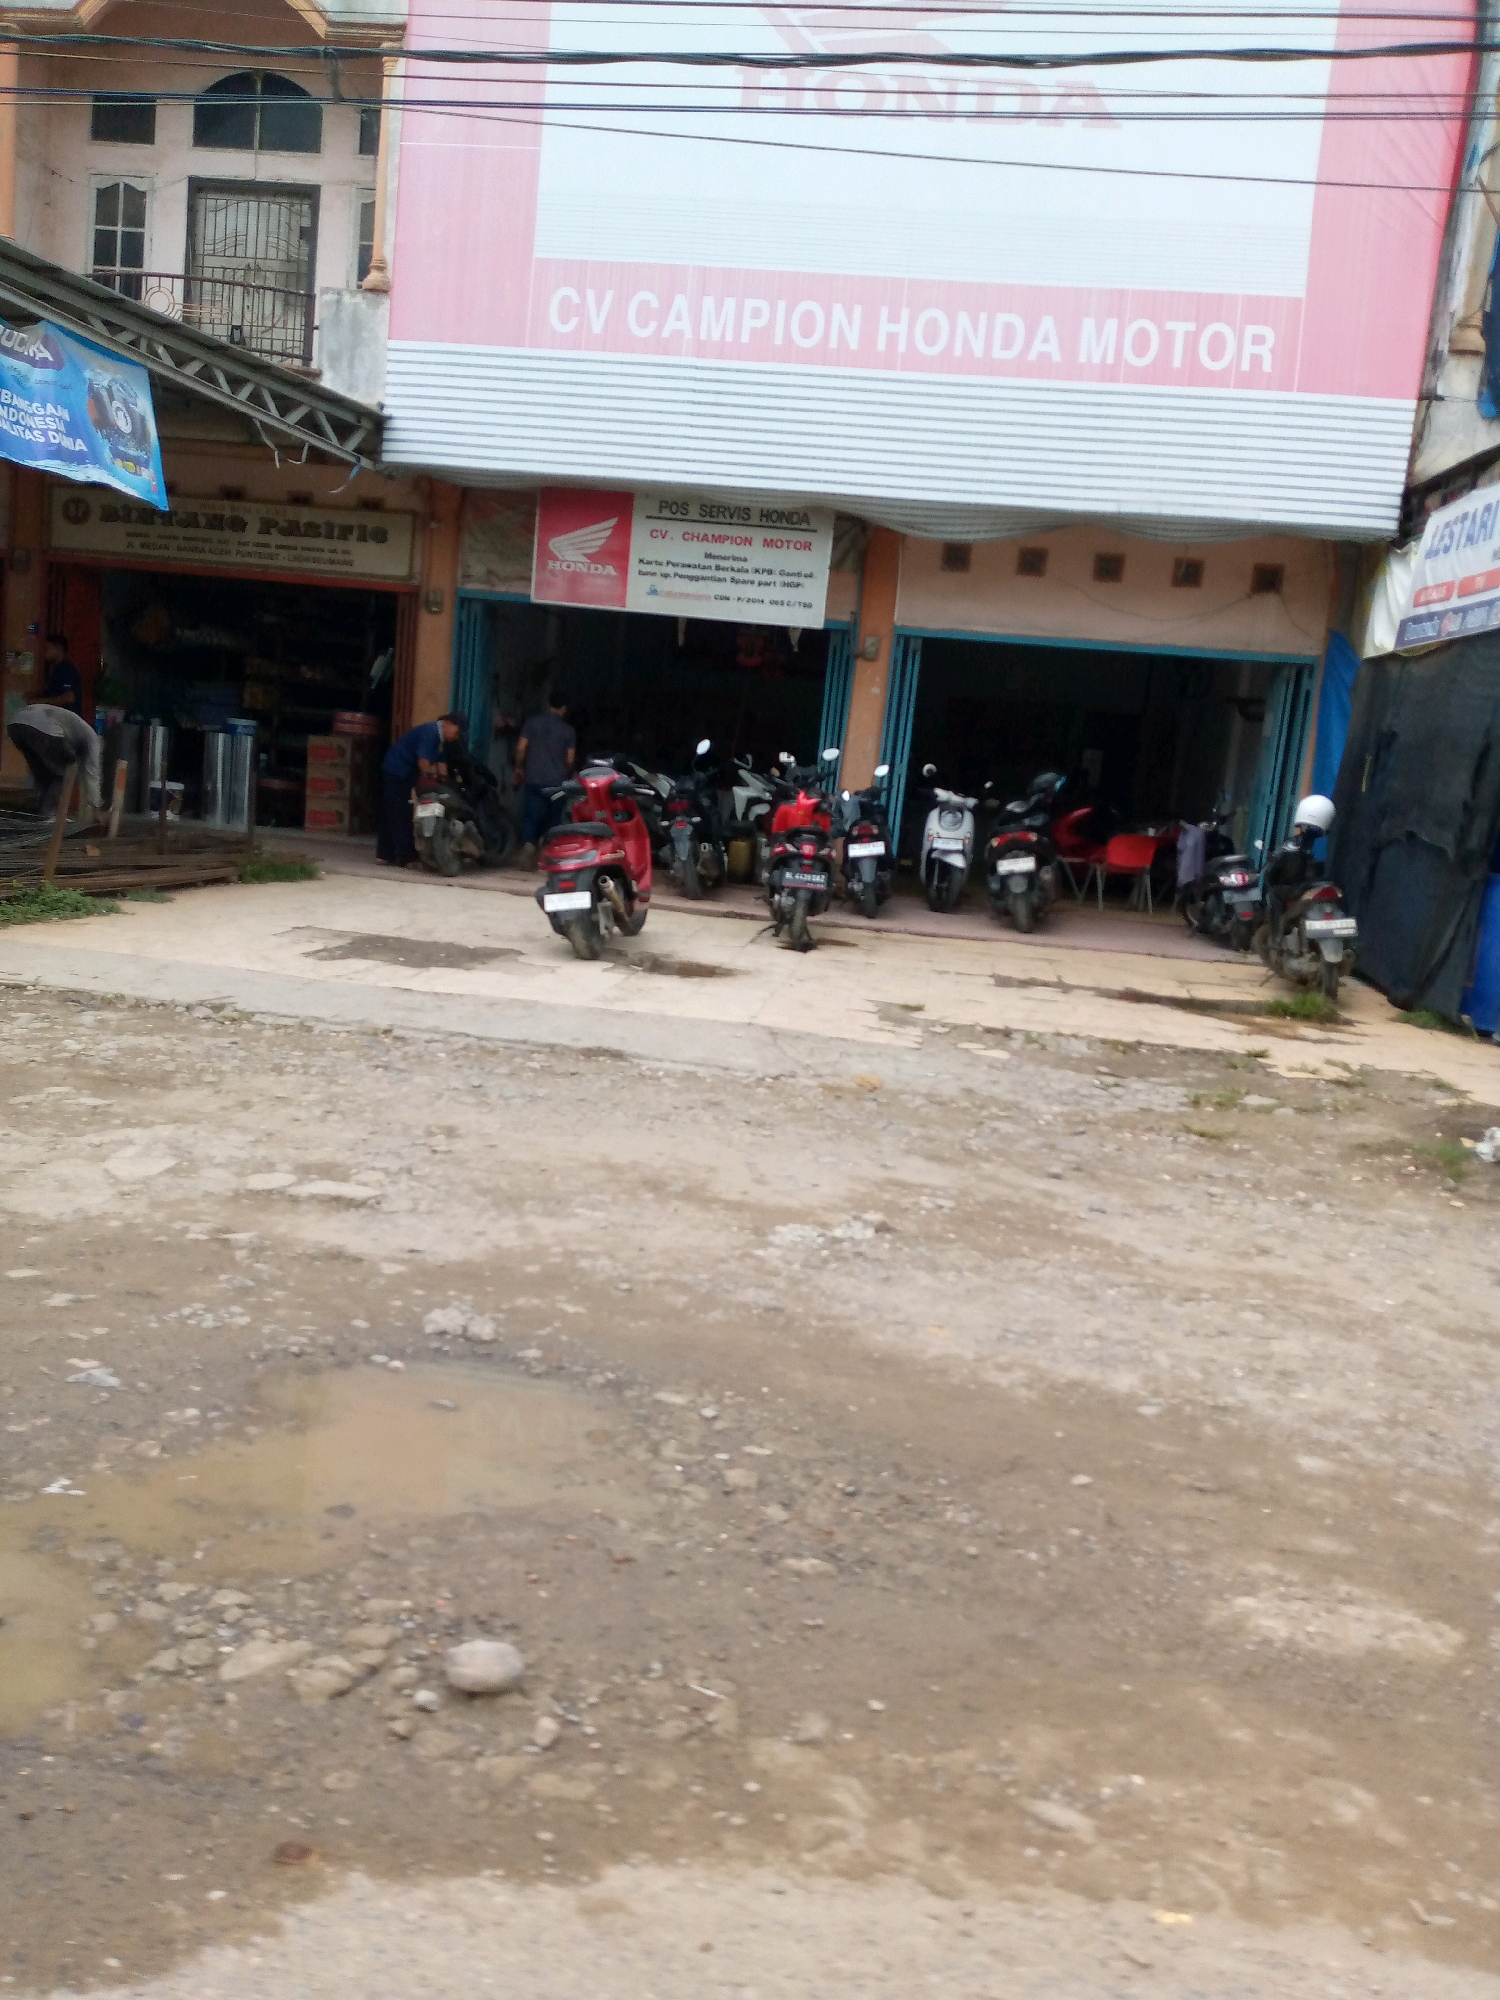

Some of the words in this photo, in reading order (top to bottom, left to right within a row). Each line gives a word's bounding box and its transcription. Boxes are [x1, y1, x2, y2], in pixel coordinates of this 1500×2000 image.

[735, 66, 1122, 129] HONDA
[549, 286, 615, 335] CV
[627, 290, 862, 350] CAMPION
[876, 306, 1061, 362] HONDA
[1078, 317, 1276, 373] MOTOR
[658, 500, 689, 516] POS
[699, 503, 751, 521] SERVIS
[759, 508, 811, 526] HONDA
[682, 531, 753, 547] CHAMPION
[763, 538, 812, 552] MOTOR
[638, 557, 664, 567] Kartu
[666, 559, 712, 571] Perawatan
[714, 563, 749, 574] Berkala
[704, 551, 748, 562] Menerima
[547, 559, 618, 576] HONDA
[673, 571, 727, 583] Penggantian
[730, 576, 756, 586] Spare
[758, 578, 777, 588] part
